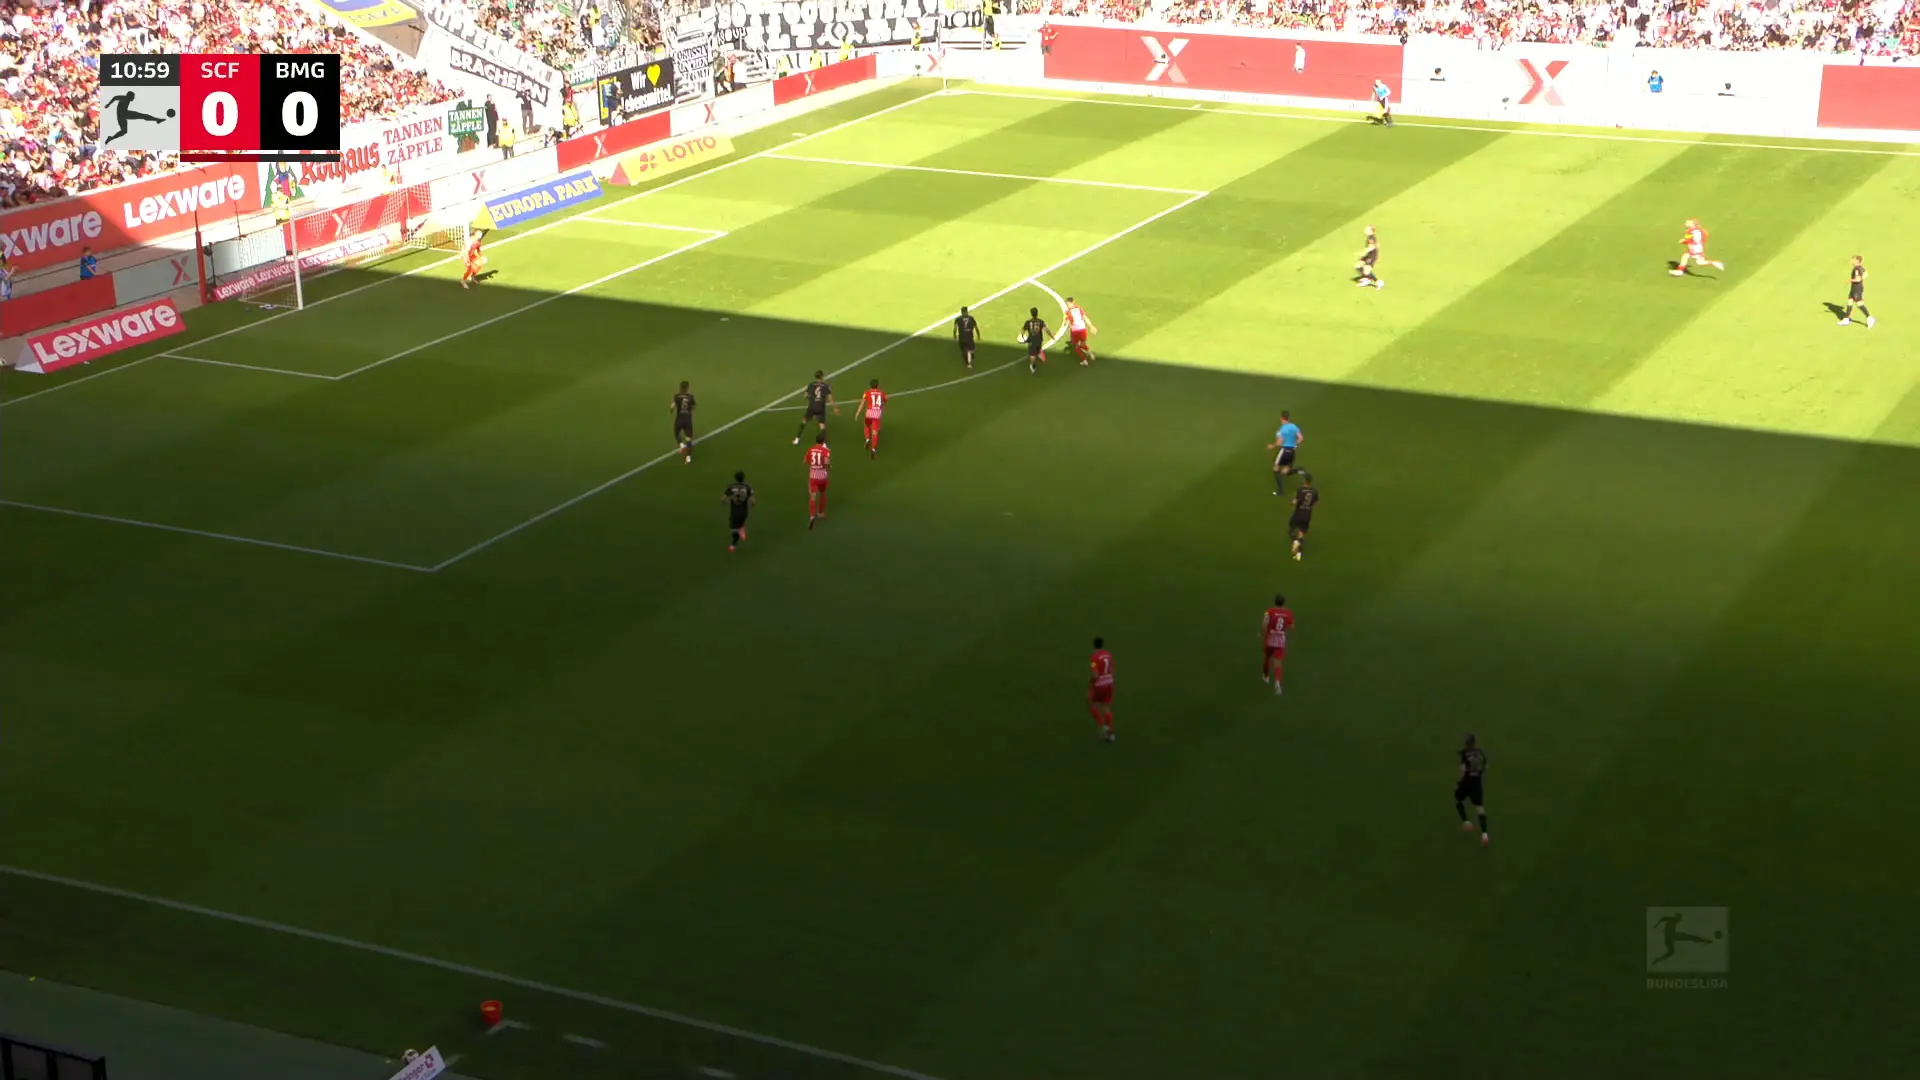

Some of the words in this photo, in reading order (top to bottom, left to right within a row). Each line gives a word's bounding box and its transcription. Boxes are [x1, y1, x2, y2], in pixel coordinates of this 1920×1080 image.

[631, 71, 647, 90] Wir
[449, 108, 483, 122] TANNEN
[451, 119, 483, 131] ZÄPFLE
[383, 116, 443, 144] TANNEN
[387, 136, 443, 165] ZÄPFLE
[663, 136, 717, 162] LOTTO
[123, 174, 246, 229] Lexware
[489, 189, 555, 223] EUROPA
[555, 175, 600, 202] PARK
[216, 276, 255, 299] Lexware
[255, 263, 297, 283] Lexware
[33, 304, 177, 366] Lexware
[871, 394, 882, 407] 14
[811, 452, 822, 465] 31
[1276, 616, 1284, 631] 8
